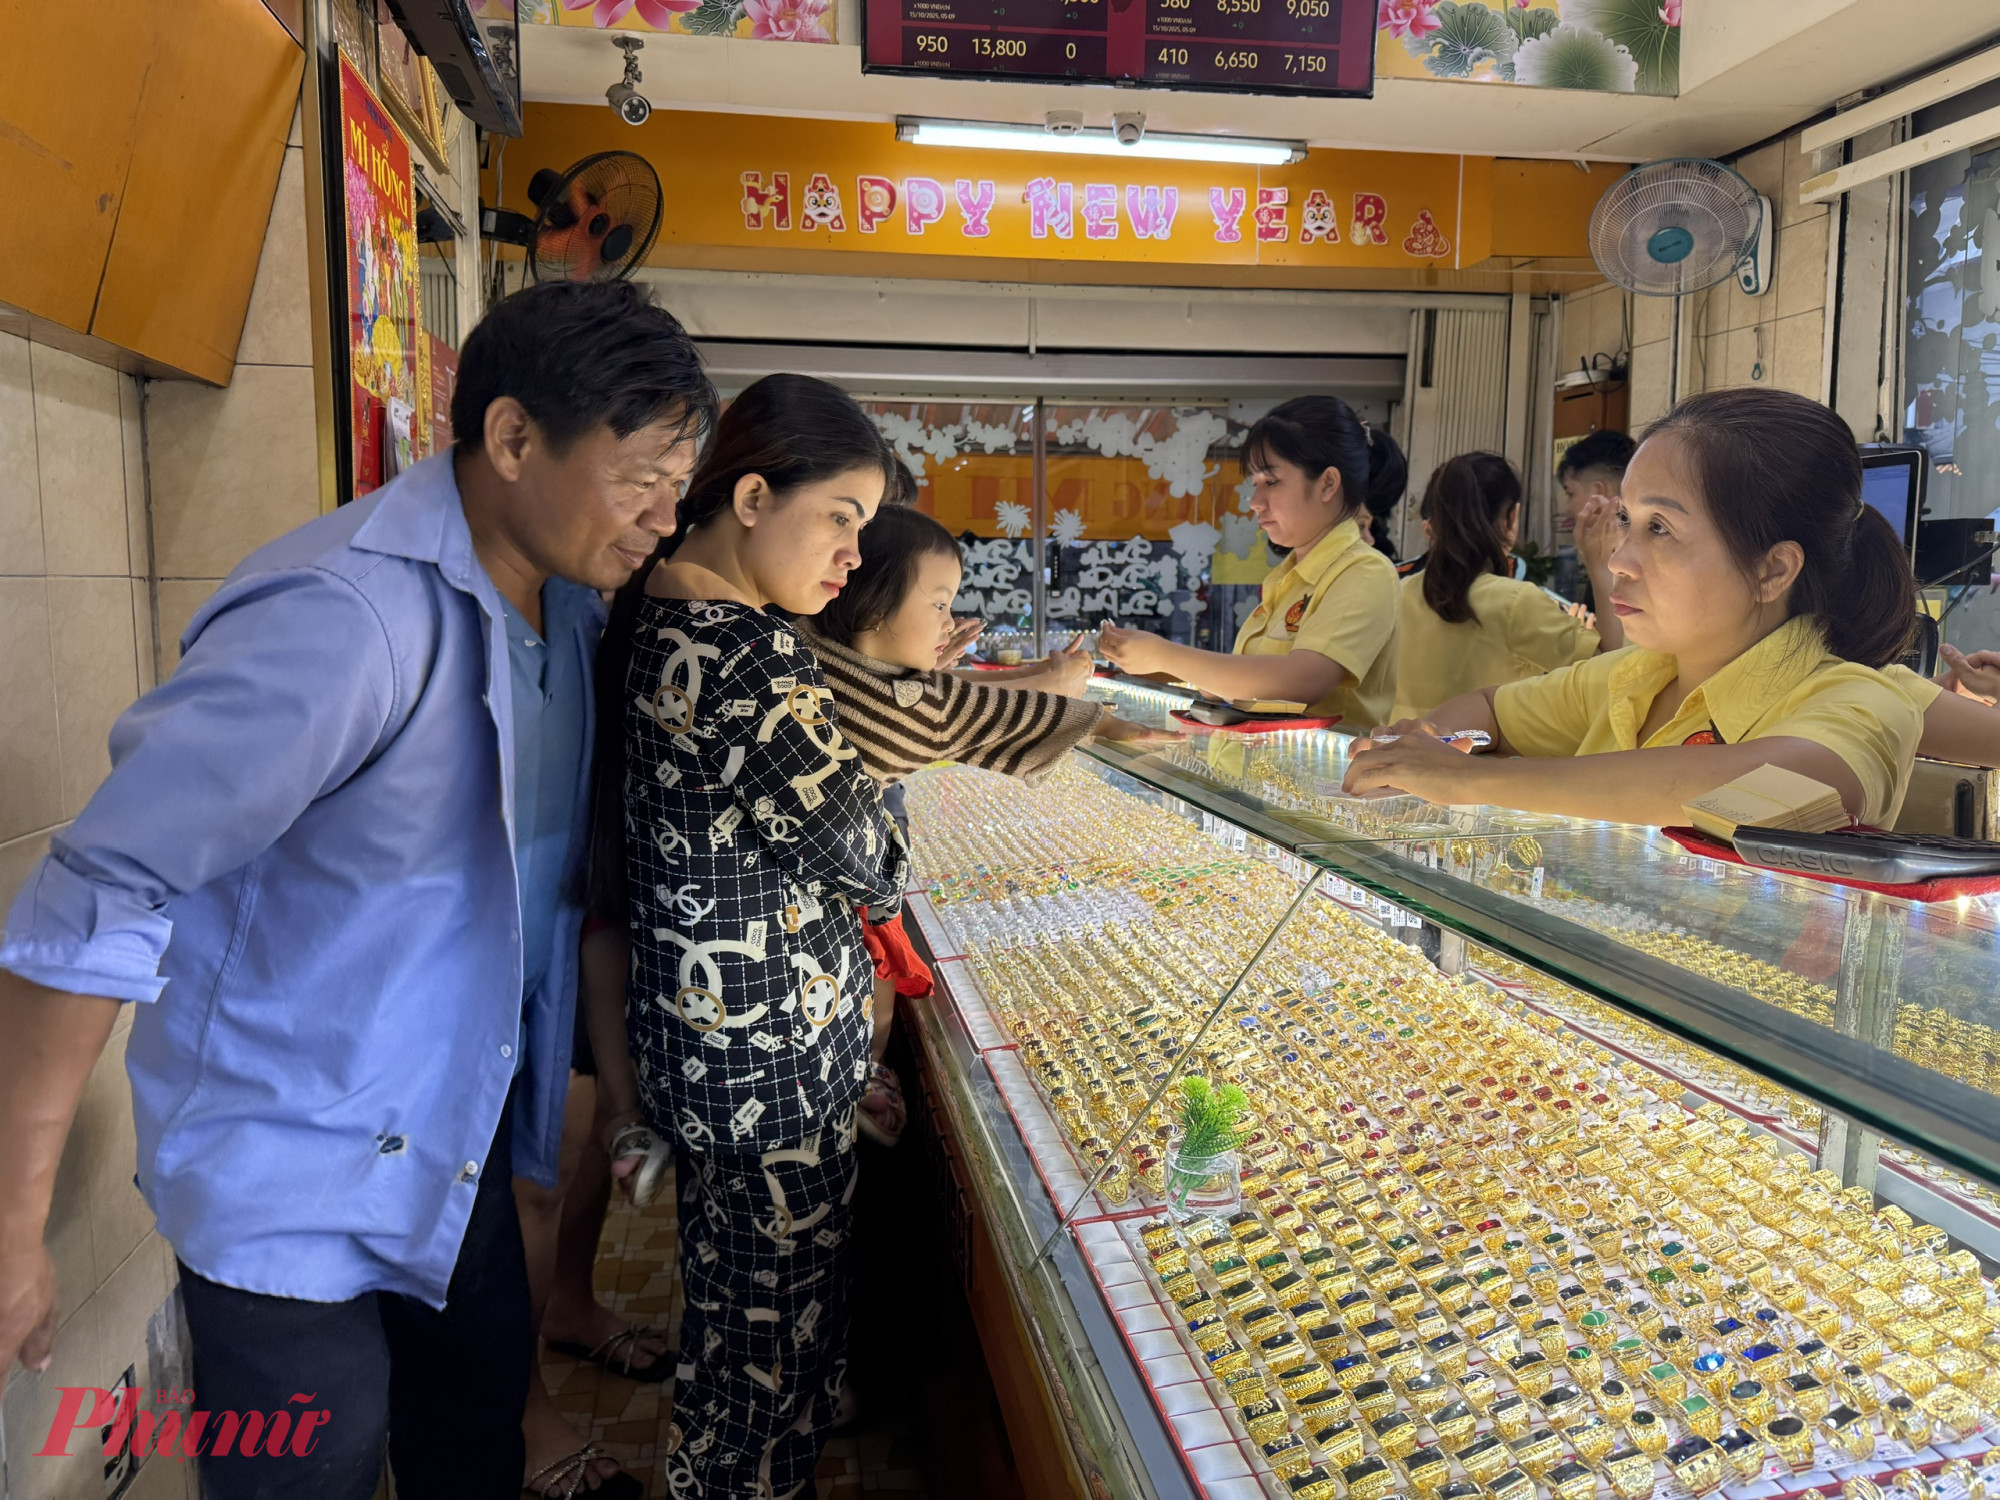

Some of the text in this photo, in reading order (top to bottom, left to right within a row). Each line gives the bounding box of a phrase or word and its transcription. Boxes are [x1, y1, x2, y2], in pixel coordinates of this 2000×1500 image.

[1287, 0, 1329, 19] 9,050
[916, 35, 948, 53] 950
[971, 37, 1027, 58] 13,800
[1065, 42, 1077, 59] 0
[1158, 47, 1188, 65] 410
[1214, 51, 1258, 71] 6,650
[1284, 54, 1327, 74] 7,150
[740, 171, 1389, 245] HAPPY NEW YEAR
[802, 787, 814, 807] CHANEL
[808, 786, 818, 801] COCO
[1756, 845, 1853, 875] CASIO
[750, 927, 758, 945] COCO
[756, 924, 764, 947] CHANEL
